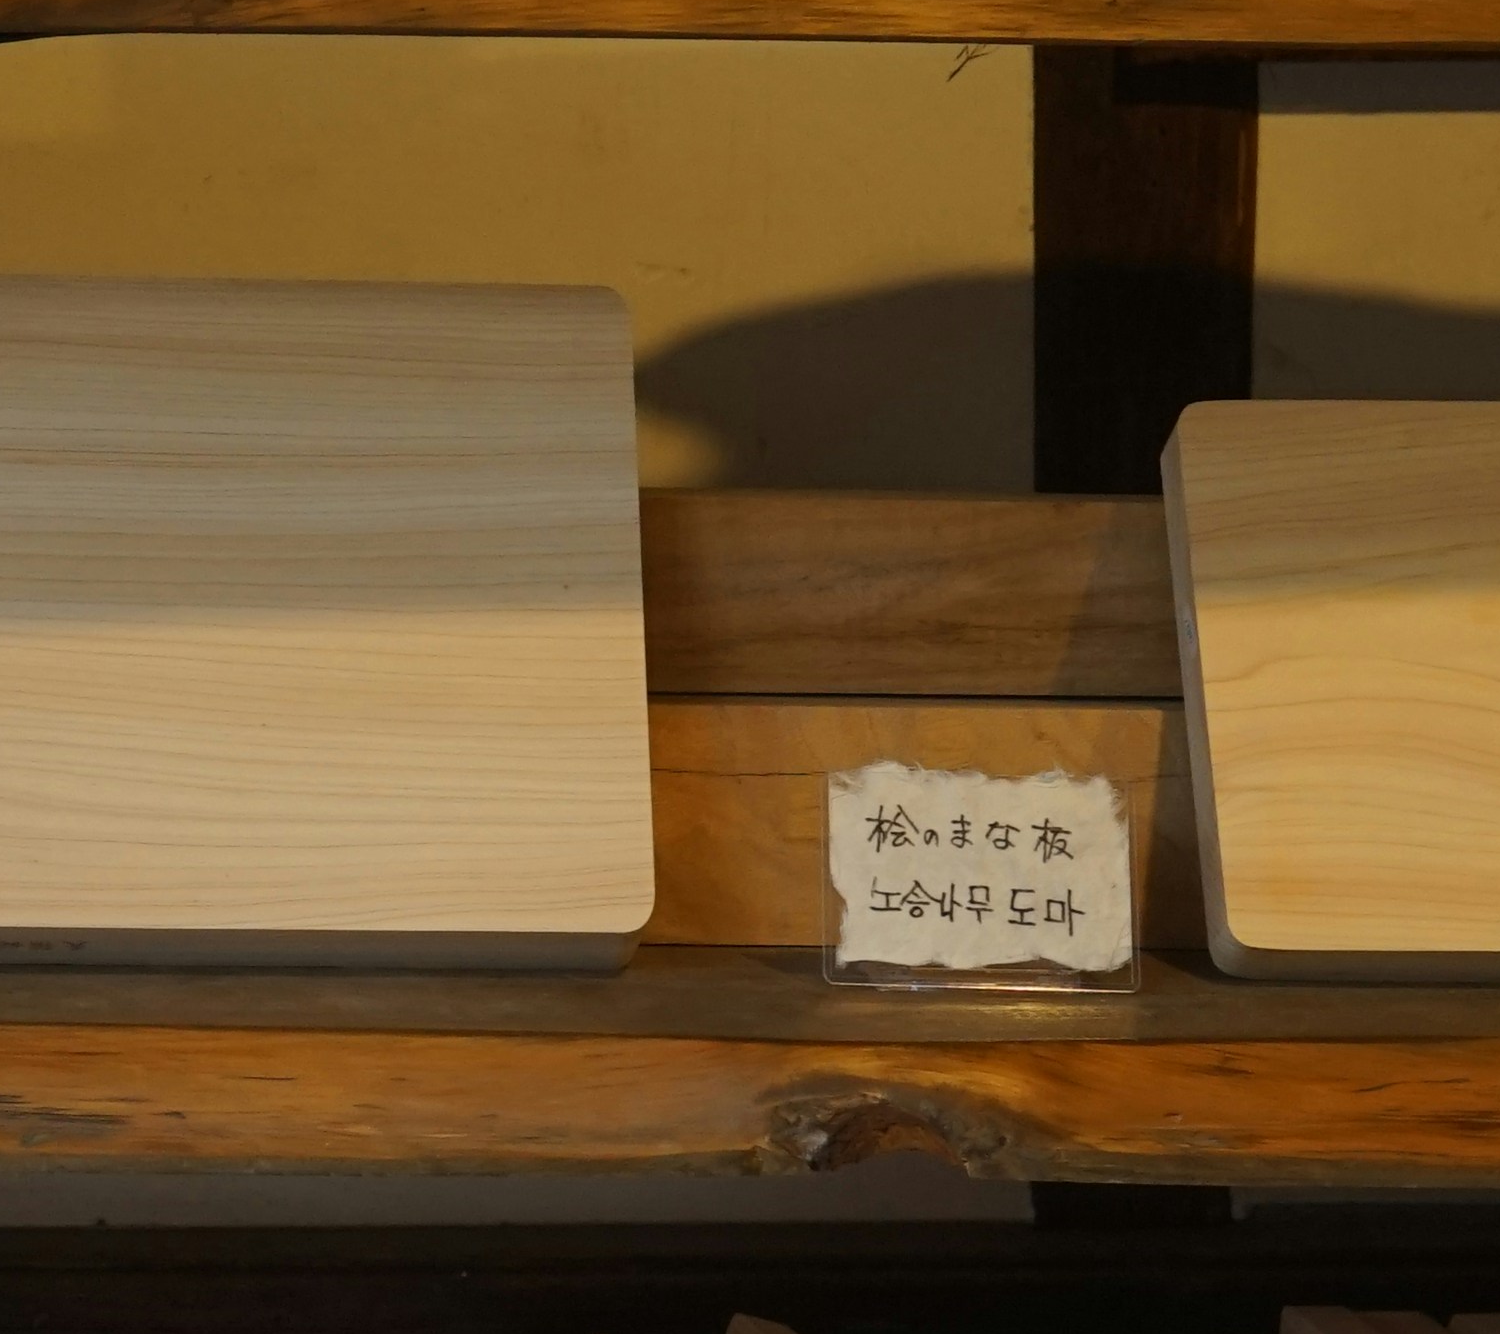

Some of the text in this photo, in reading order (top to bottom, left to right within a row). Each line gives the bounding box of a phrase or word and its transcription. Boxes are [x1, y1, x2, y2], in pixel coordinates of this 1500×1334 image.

[865, 804, 1075, 864] 桧のまな板
[1007, 888, 1086, 937] 도마
